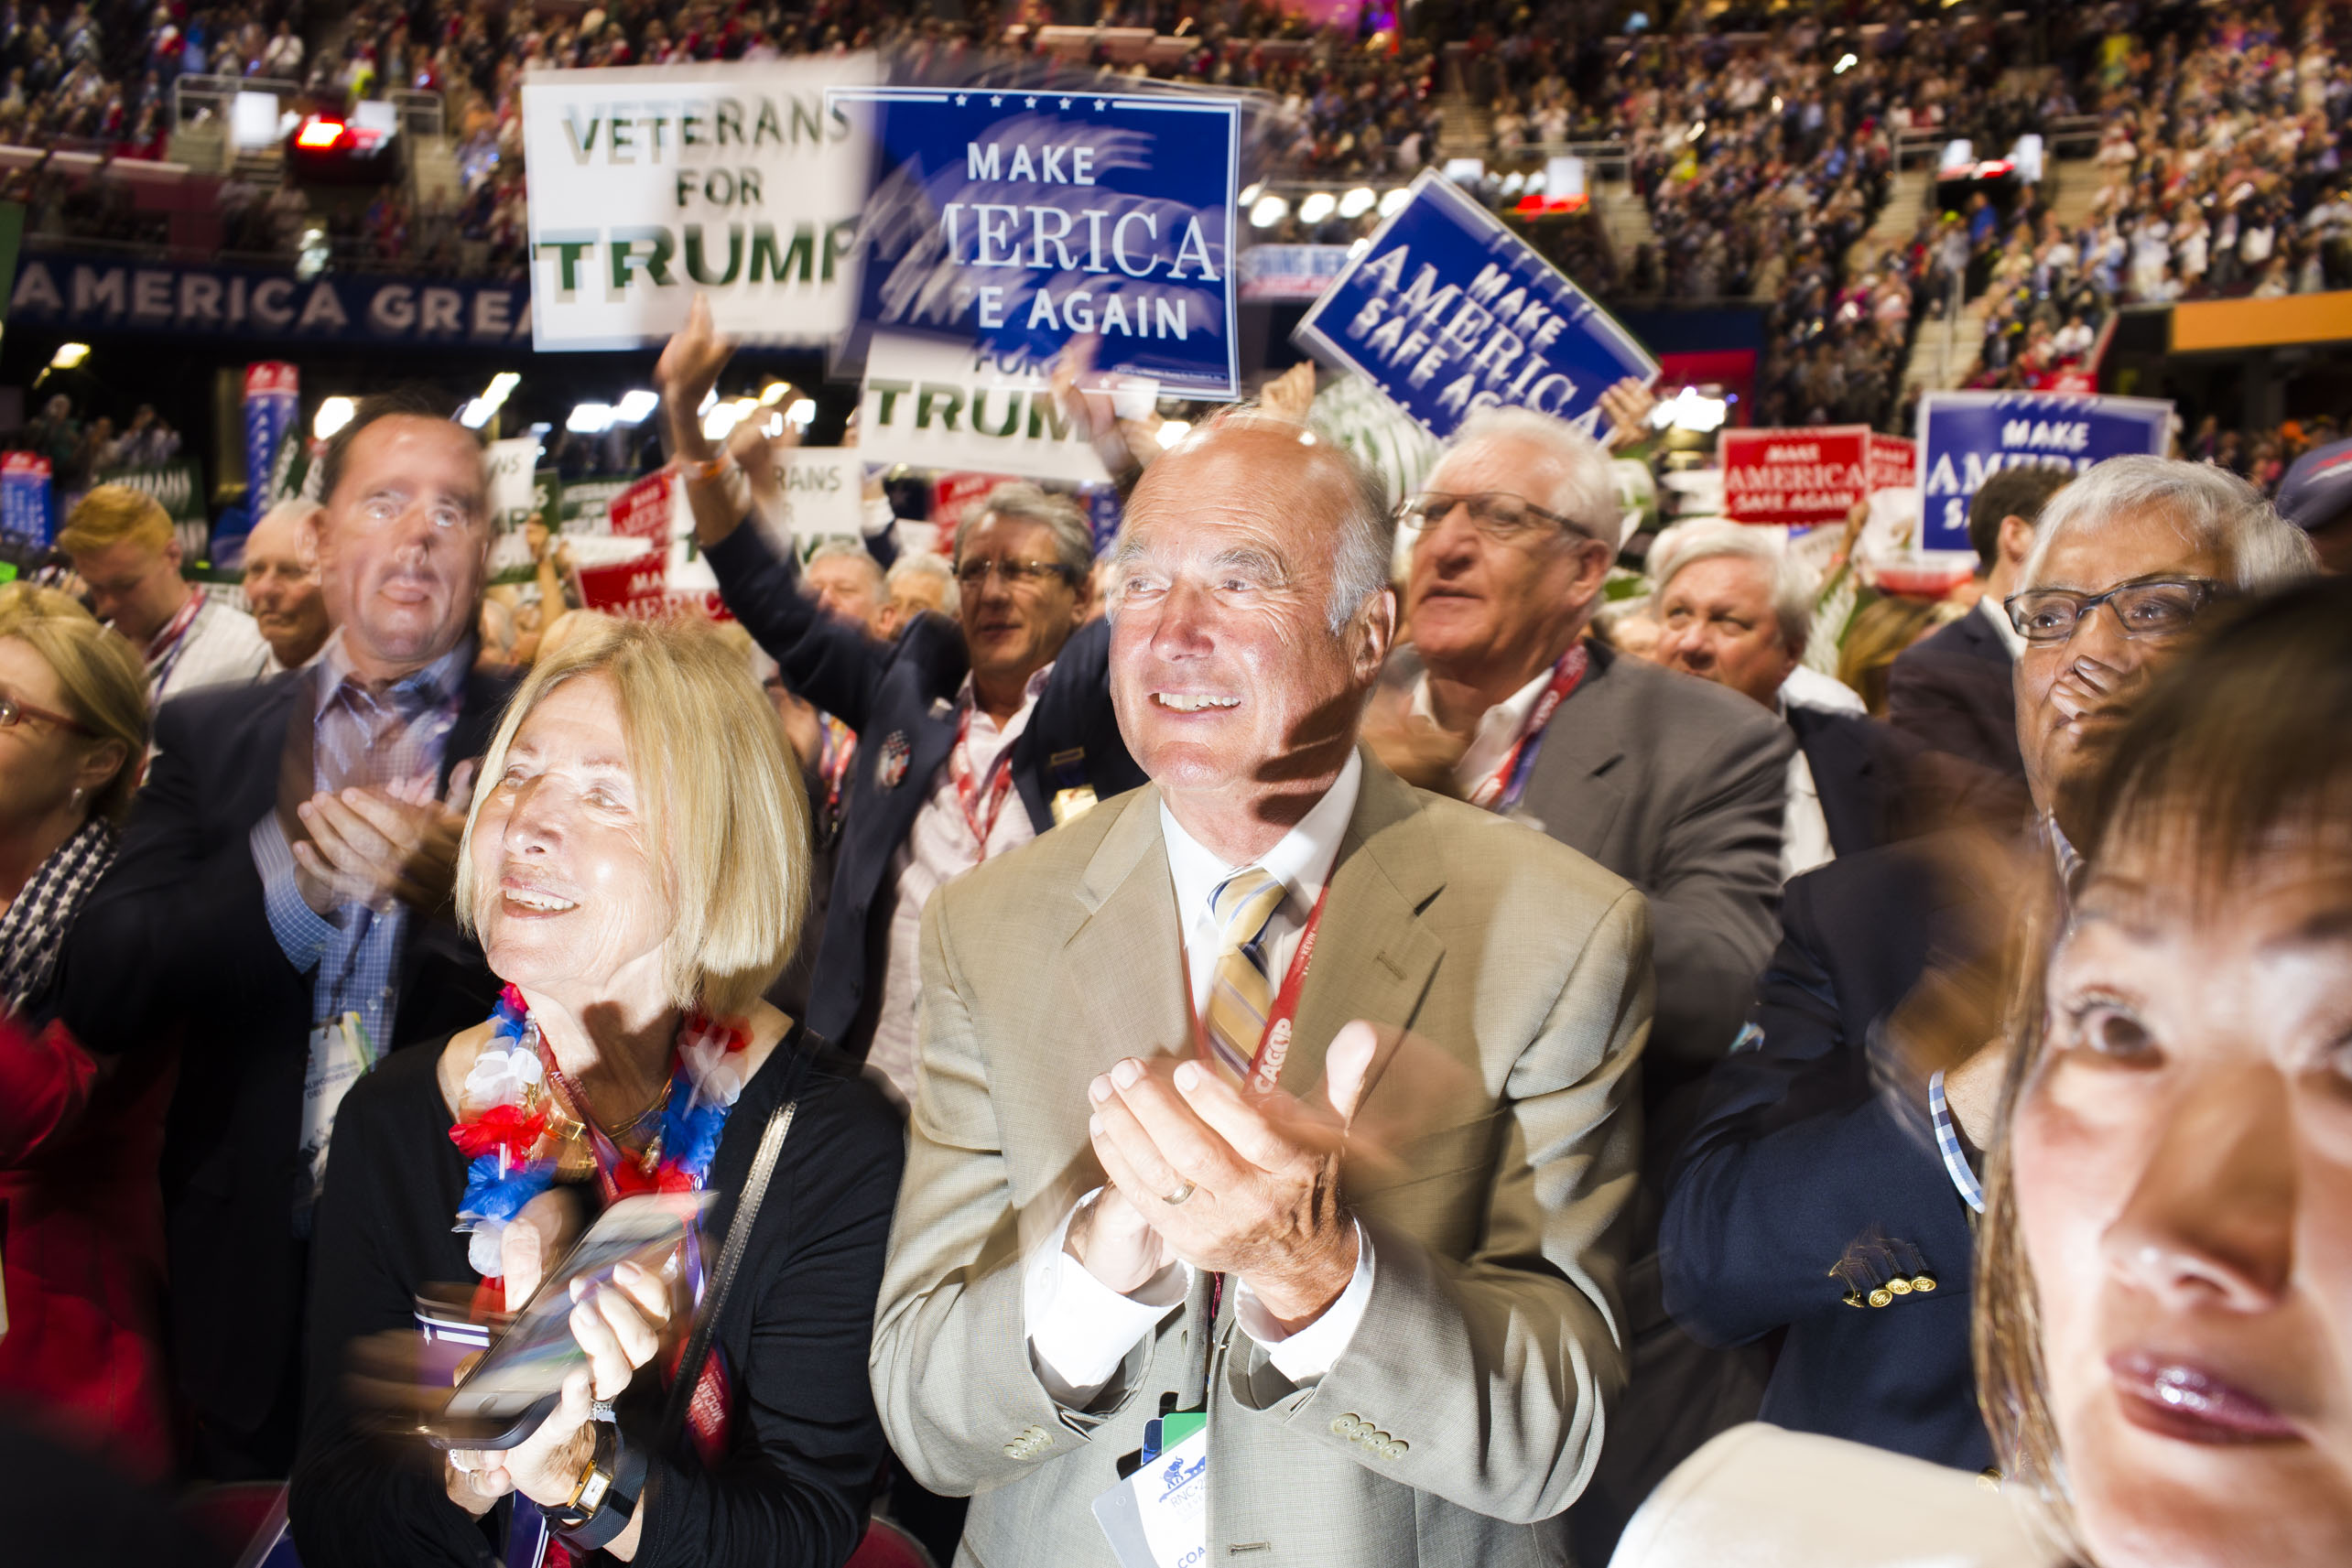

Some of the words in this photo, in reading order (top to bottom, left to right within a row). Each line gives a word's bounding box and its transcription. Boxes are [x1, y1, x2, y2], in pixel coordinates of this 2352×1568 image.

[560, 93, 852, 166] VETERANS
[675, 166, 765, 209] FOR
[967, 142, 1096, 186] MAKE
[533, 222, 862, 304] TRUMP
[13, 262, 349, 328] AMERICA
[1026, 287, 1188, 341] AGAIN
[1467, 262, 1567, 351] MAKE
[1347, 298, 1449, 392] SAFE
[868, 376, 1096, 442] TRUM
[2002, 418, 2090, 452] MAKE
[1727, 462, 1866, 492] AMERICA
[1300, 931, 1317, 957] KEVIN
